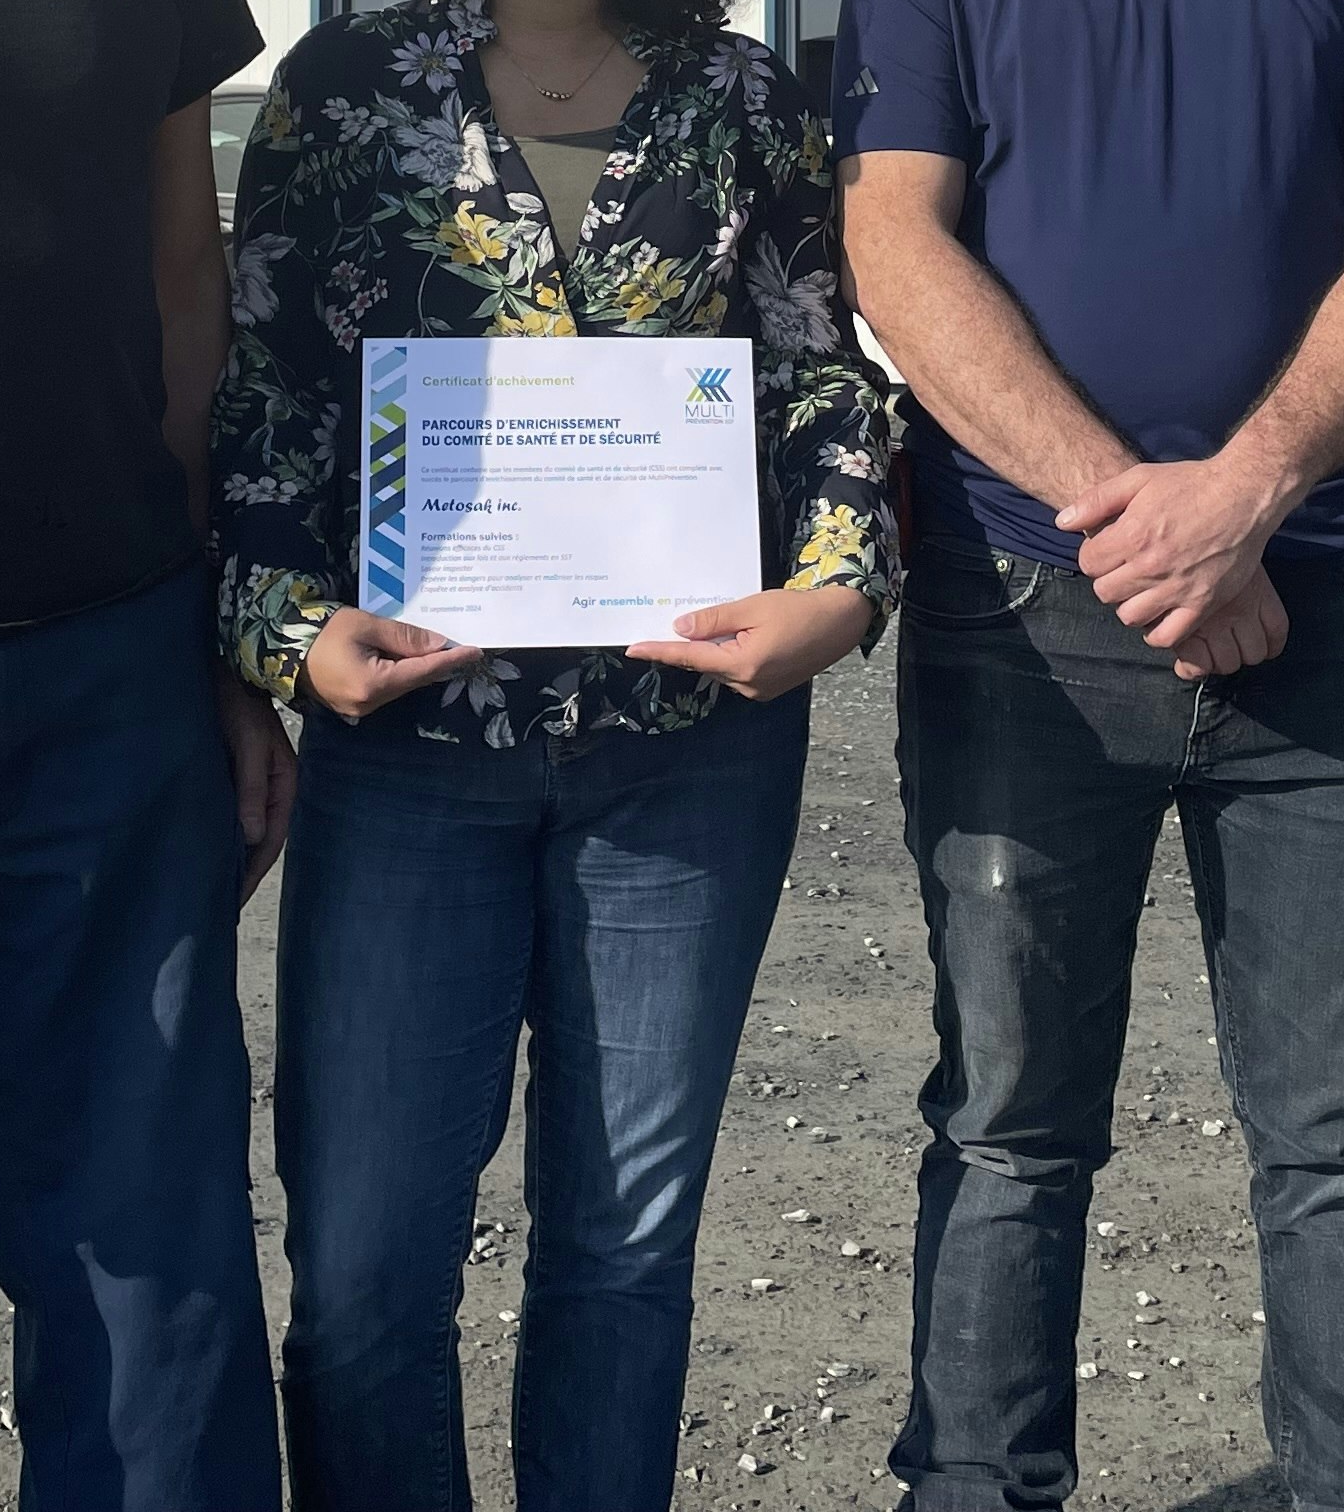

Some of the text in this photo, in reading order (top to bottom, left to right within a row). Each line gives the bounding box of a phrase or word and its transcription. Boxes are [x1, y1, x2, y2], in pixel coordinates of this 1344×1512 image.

[422, 375, 575, 387] Certificat d'achèvement
[685, 404, 735, 418] MULTI
[422, 418, 621, 430] PARCOURS D'ENRICHISSEMENT
[422, 431, 662, 446] DU COMITÉ DE SANTÉ ET DE SÉCURITÉ
[421, 498, 522, 514] Metosak inc.
[421, 532, 477, 541] Formations
[479, 532, 513, 541] suivies
[572, 596, 596, 608] Agir
[600, 596, 654, 606] ensemble
[657, 598, 671, 606] en
